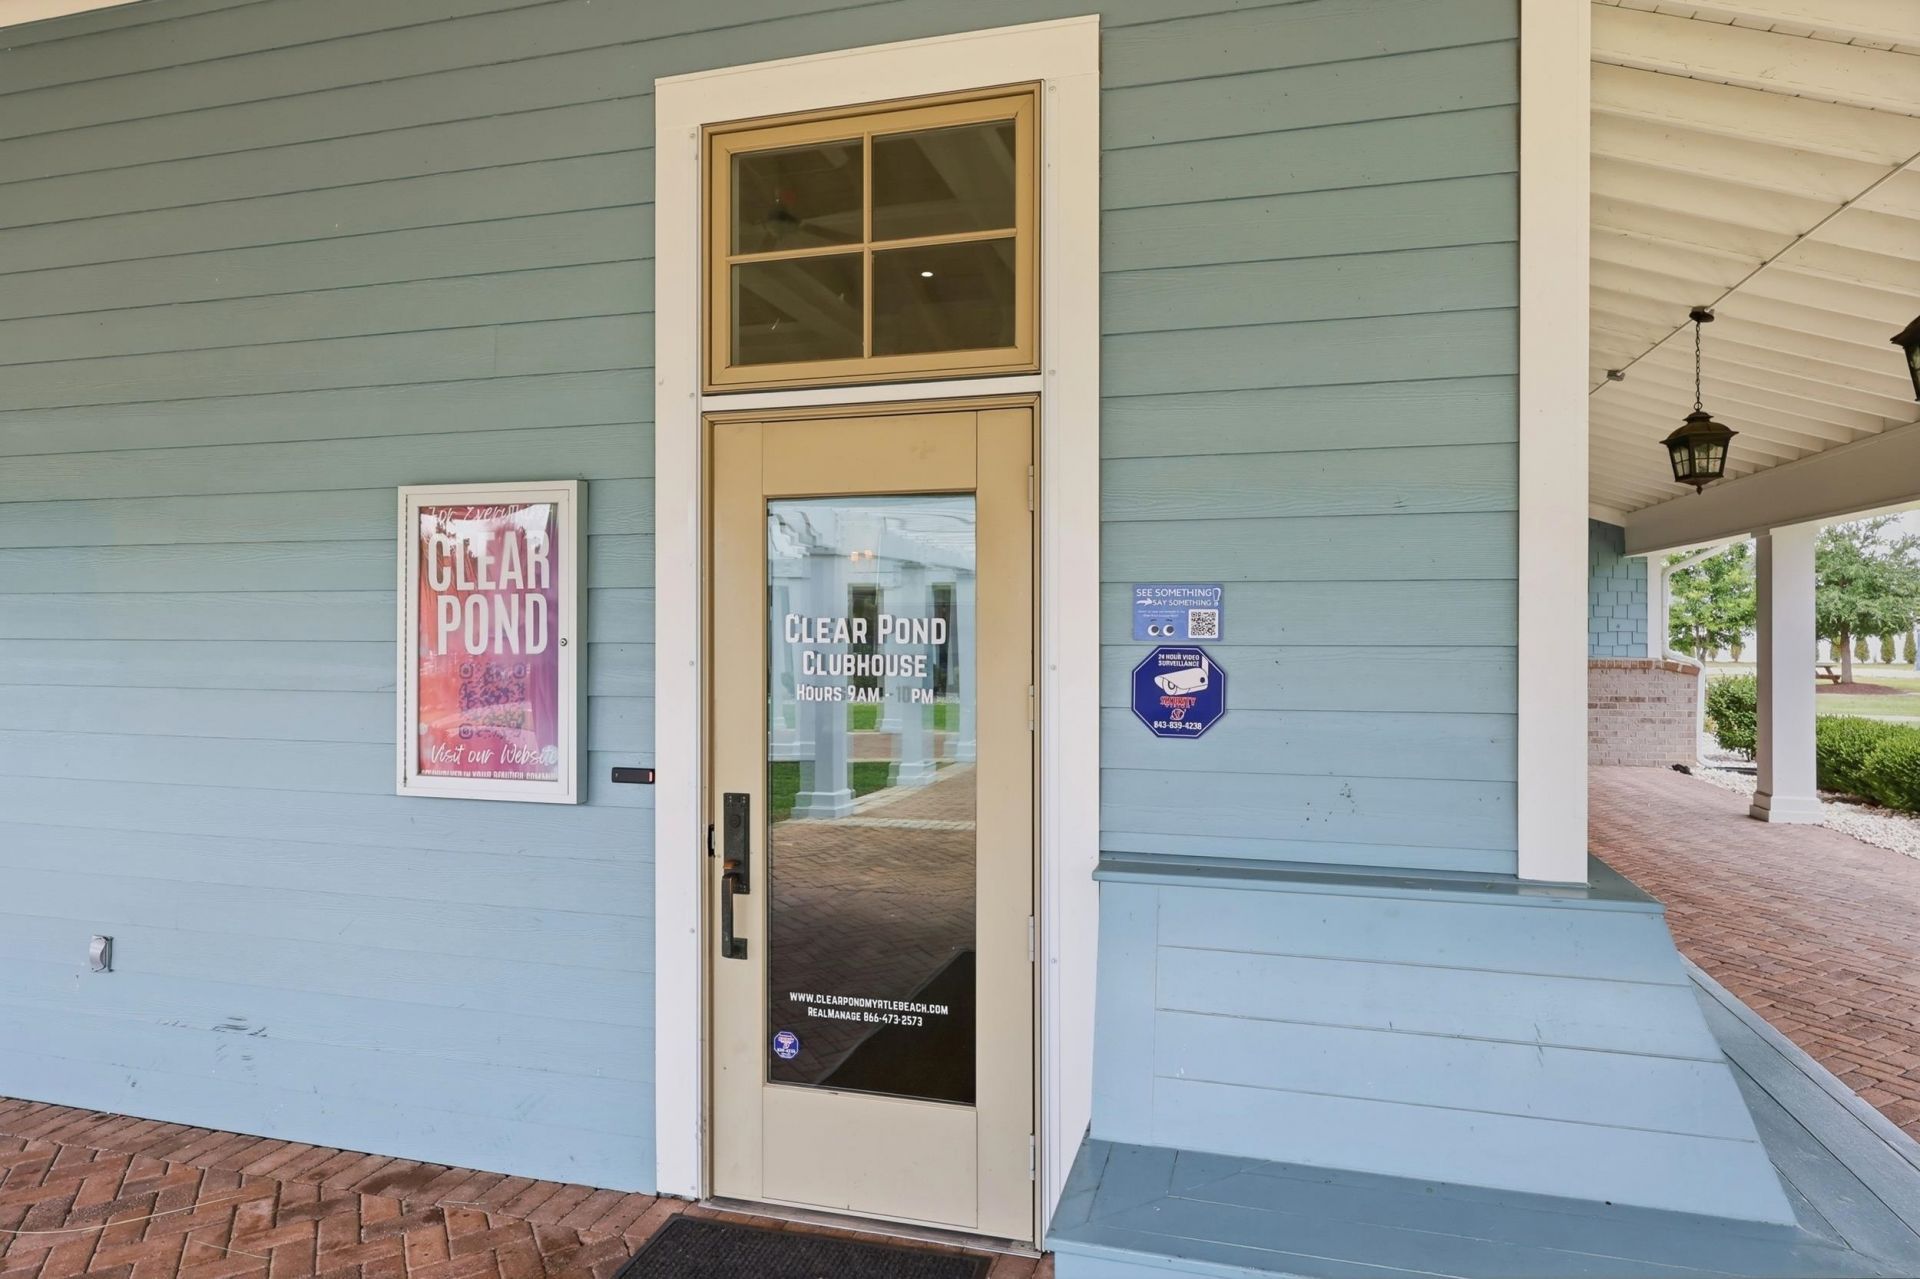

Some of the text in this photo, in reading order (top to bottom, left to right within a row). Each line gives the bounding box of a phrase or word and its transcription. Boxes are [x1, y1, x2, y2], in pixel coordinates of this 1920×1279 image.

[428, 531, 550, 591] CLEAR
[1136, 588, 1153, 597] SEE
[1155, 588, 1212, 597] SOMETHING
[437, 593, 548, 655] POND
[785, 613, 947, 645] CLEAR POND
[802, 650, 928, 678] CLUBHOUSE
[796, 684, 842, 701] HOURS
[847, 684, 880, 703] 9AM
[911, 688, 934, 704] PM
[1153, 720, 1202, 730] 843-839-4238
[431, 742, 465, 765] Visit
[467, 748, 494, 764] our
[789, 991, 949, 1015] WWW.CLEARPONDMYRTLEBEACH.COM
[863, 1013, 923, 1027] 866-473-2573
